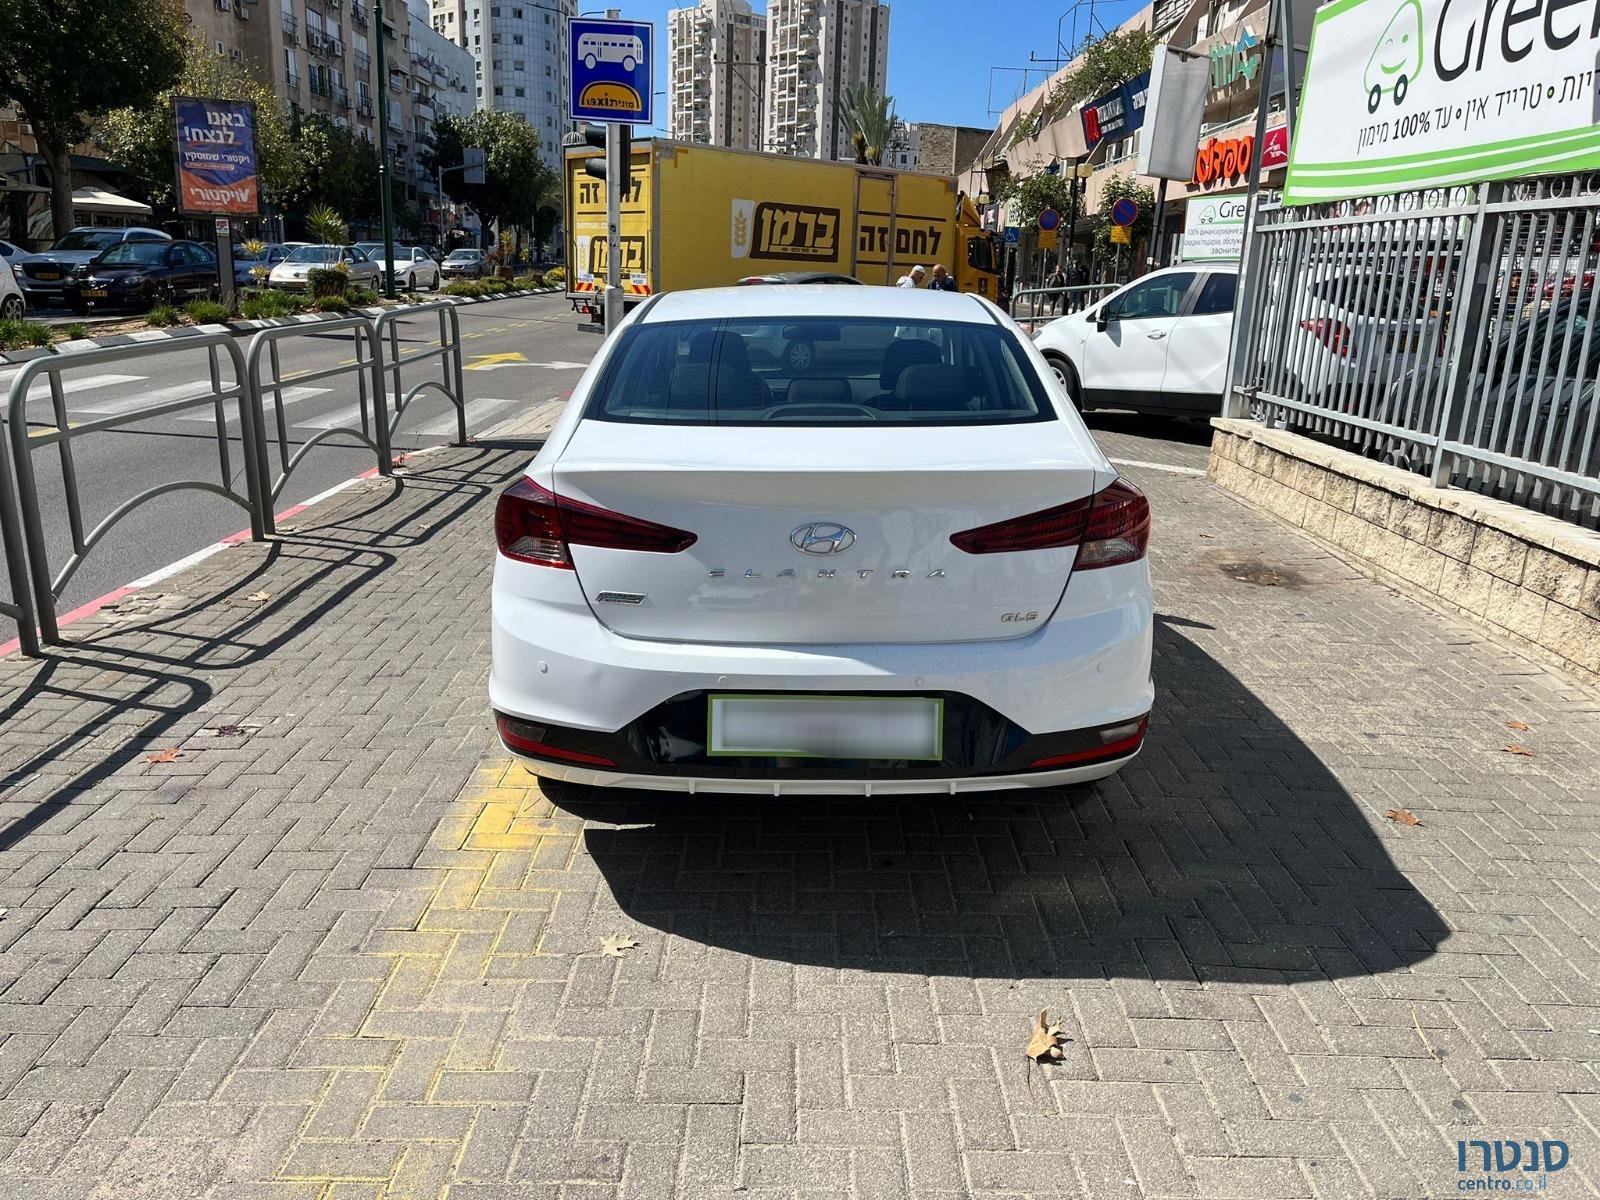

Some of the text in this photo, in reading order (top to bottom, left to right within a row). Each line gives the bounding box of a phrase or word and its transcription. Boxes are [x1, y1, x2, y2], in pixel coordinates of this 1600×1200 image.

[1434, 0, 1600, 82] Gree
[610, 98, 634, 108] מונית
[1357, 69, 1600, 155] יות טרייד אין עד 100% מימון
[207, 111, 246, 127] באנו
[184, 126, 235, 144] לנצח!
[185, 152, 250, 164] ויקטורי שמוטקין
[580, 183, 599, 203] זה
[760, 207, 836, 253] ברמן
[860, 225, 942, 256] לחם זה
[709, 568, 947, 580] ELANTRA
[1000, 611, 1038, 623] GLS
